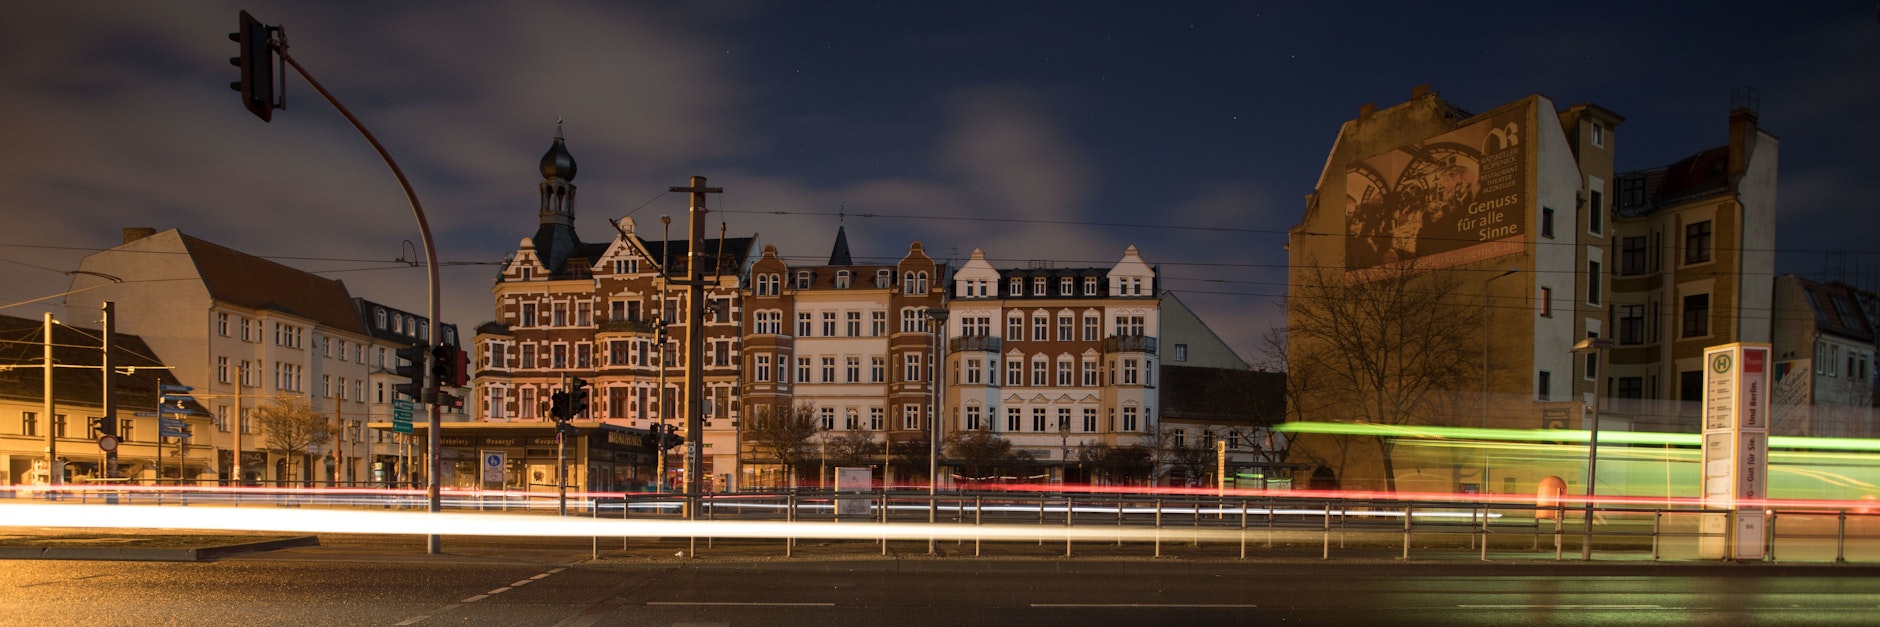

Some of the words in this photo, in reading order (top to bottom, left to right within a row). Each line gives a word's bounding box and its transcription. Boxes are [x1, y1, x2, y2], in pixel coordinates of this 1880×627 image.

[1480, 165, 1518, 181] RESTAURANT
[1487, 174, 1513, 186] THEATER
[1468, 193, 1518, 215] Genuss
[1457, 217, 1477, 233] für
[1479, 211, 1504, 227] alle
[1479, 223, 1518, 242] Sinne
[1746, 357, 1762, 366] Tram
[1750, 380, 1758, 407] Berlin.
[1749, 408, 1757, 426] Und
[608, 431, 643, 447] BRAUHAUS
[1748, 436, 1756, 451] Sie.
[1748, 452, 1756, 466] für
[1747, 466, 1755, 482] Gut
